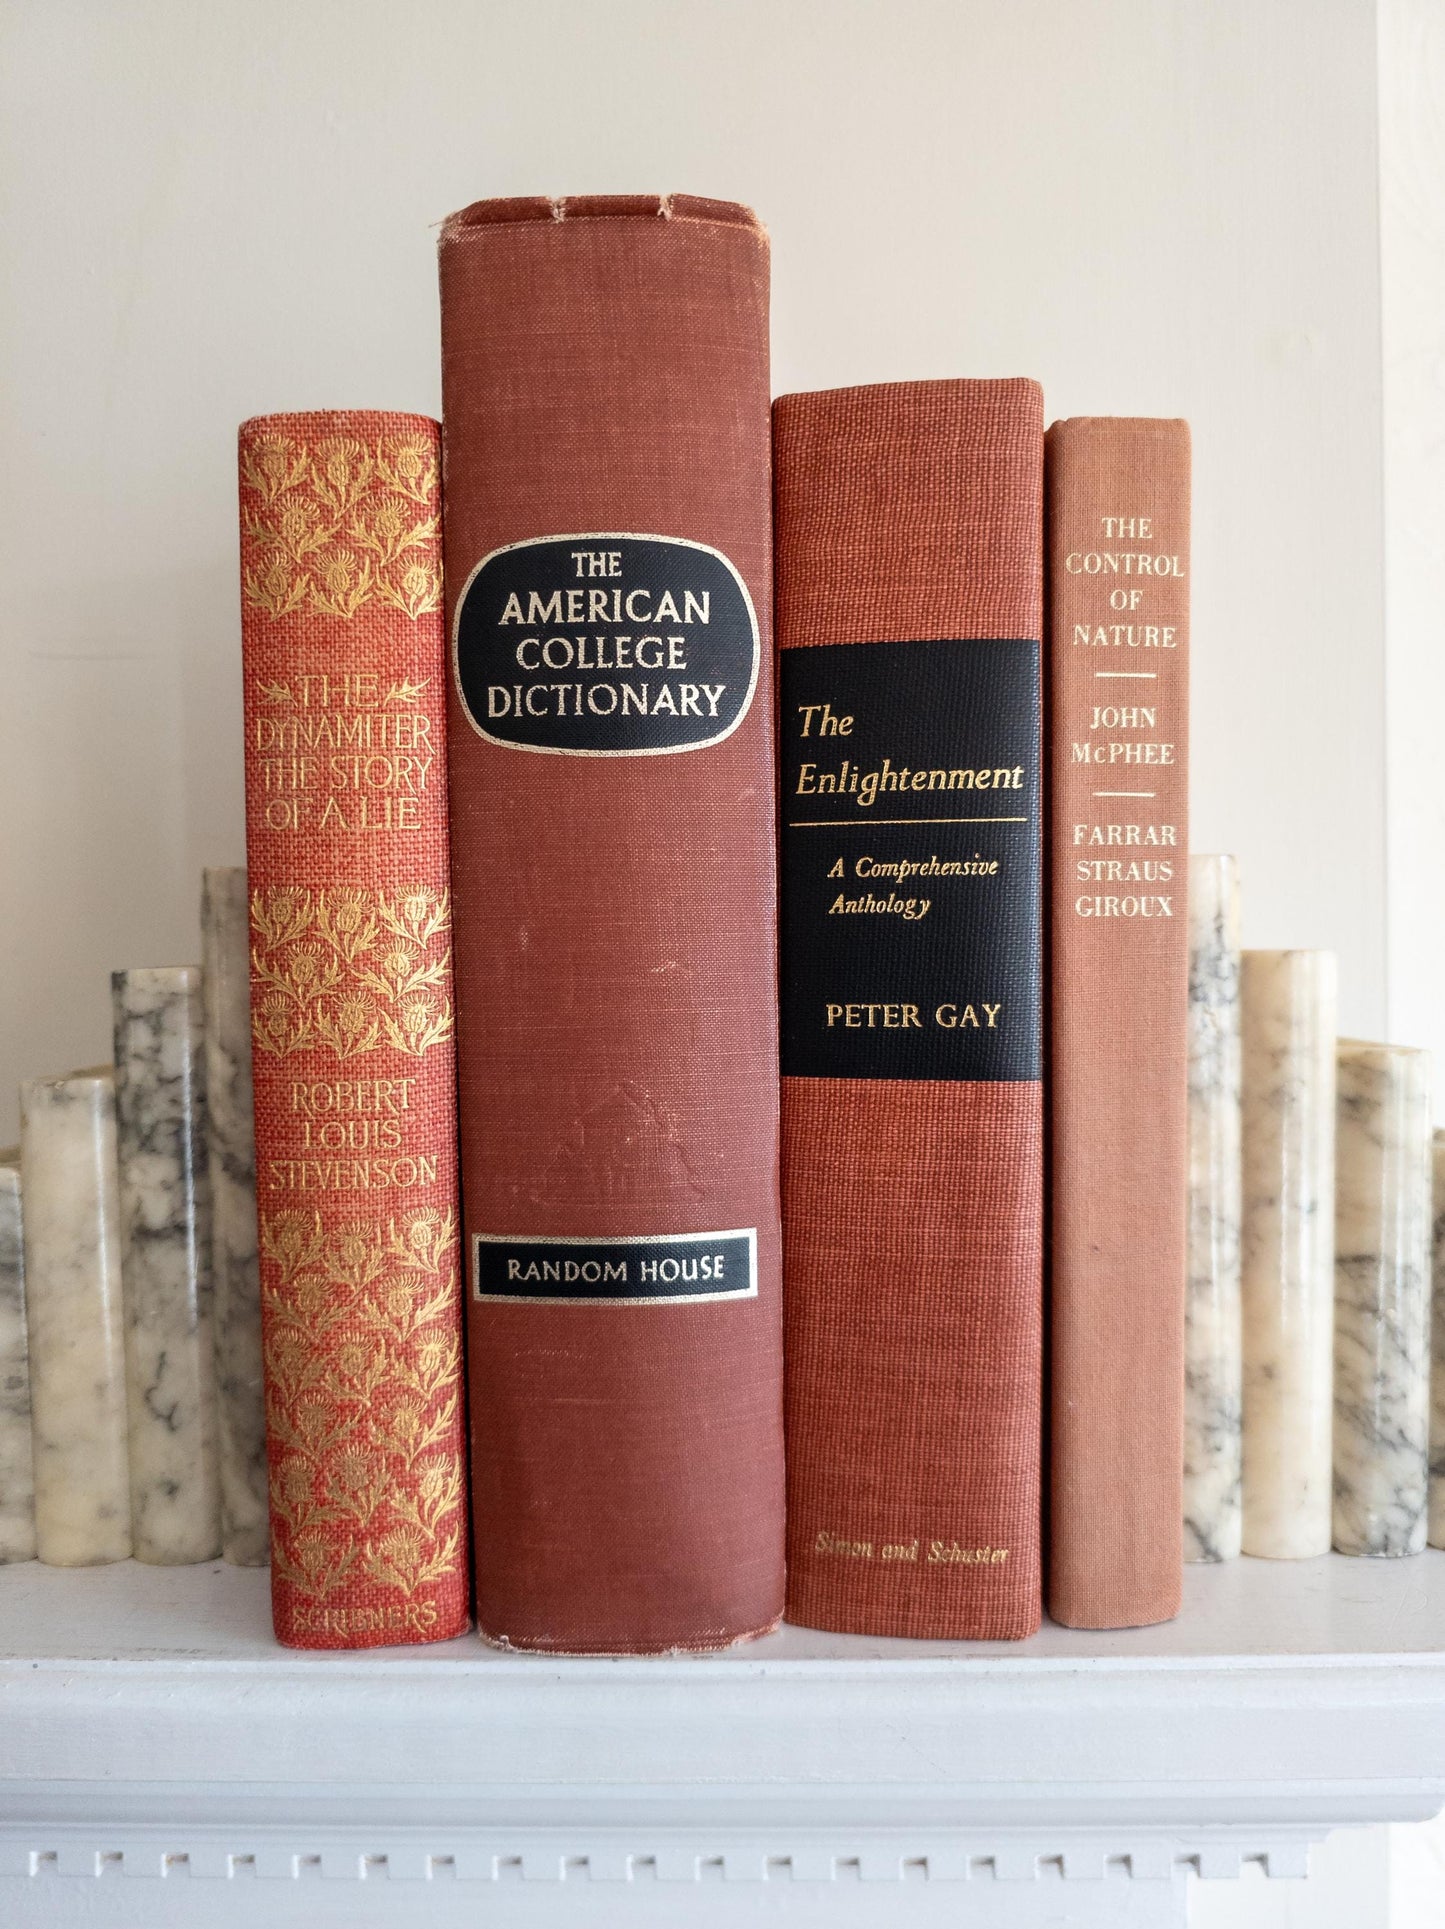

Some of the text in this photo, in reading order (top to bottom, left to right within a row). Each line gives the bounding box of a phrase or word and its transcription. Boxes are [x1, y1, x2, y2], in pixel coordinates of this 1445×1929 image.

[1102, 517, 1152, 539] THE
[571, 551, 622, 577] THE
[1065, 552, 1185, 577] CONTROL
[498, 589, 710, 625] AMERICAN
[1110, 589, 1144, 611] OF
[1073, 625, 1177, 648] NATURE
[516, 636, 687, 670] COLLEGE
[295, 674, 379, 707] THE
[487, 683, 726, 718] DICTIONARY
[798, 703, 855, 738] The
[1090, 706, 1157, 729] JOHN
[256, 714, 437, 755] DYNAMITER
[1071, 742, 1175, 765] McPHEE
[258, 755, 433, 795] THE STORY
[795, 759, 1025, 807] Enlightenment
[266, 796, 421, 830] OF A LIE
[1072, 824, 1176, 846] FARRAR
[827, 852, 999, 883] A Comprehensive
[1076, 860, 1173, 881] STRAUS
[828, 893, 931, 920] Anthology
[1075, 896, 1173, 917] GIROUX
[826, 1003, 1001, 1028] PETER GAY
[290, 1078, 416, 1119] ROBERT
[303, 1119, 402, 1150] LOUIS
[269, 1154, 438, 1190] STEVENSON
[508, 1255, 725, 1282] RANDOM HOUSE
[815, 1530, 1010, 1565] Simon and Schuster
[292, 1600, 438, 1639] SCRIBNERS
